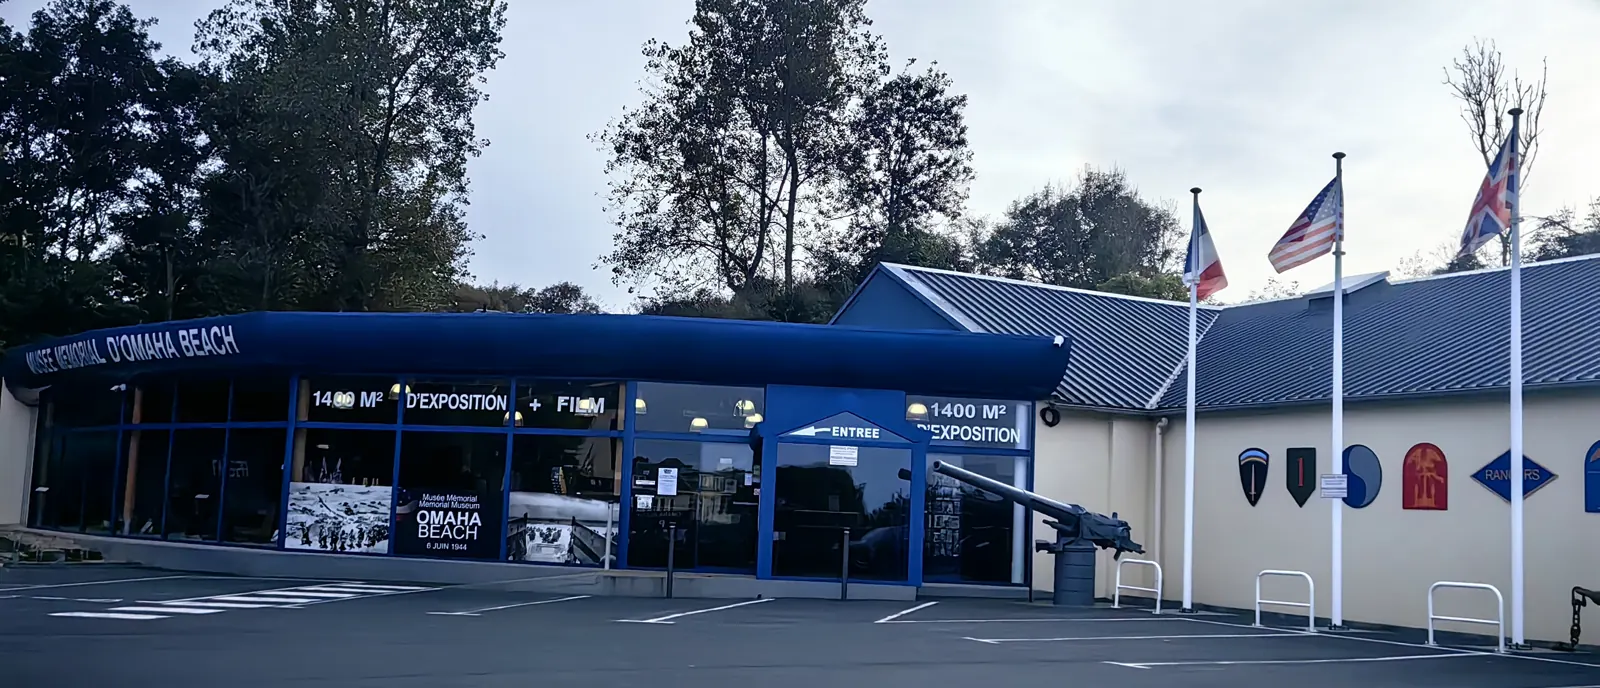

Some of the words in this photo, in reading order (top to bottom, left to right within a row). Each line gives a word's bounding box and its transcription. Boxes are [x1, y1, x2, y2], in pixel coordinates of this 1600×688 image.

[106, 331, 181, 362] D'OMAHA
[178, 325, 240, 357] BEACH
[313, 390, 355, 407] 1400
[406, 393, 507, 411] D'EXPOSITION
[529, 398, 542, 411] +
[557, 396, 605, 413] FILM
[930, 402, 976, 419] 1400
[832, 426, 880, 439] ENTREE
[1485, 468, 1540, 481] RANRS
[451, 501, 480, 509] Museum
[416, 510, 482, 526] OMAHA
[418, 524, 478, 540] BEACH
[432, 542, 449, 550] JUIN
[451, 543, 467, 551] 1944
